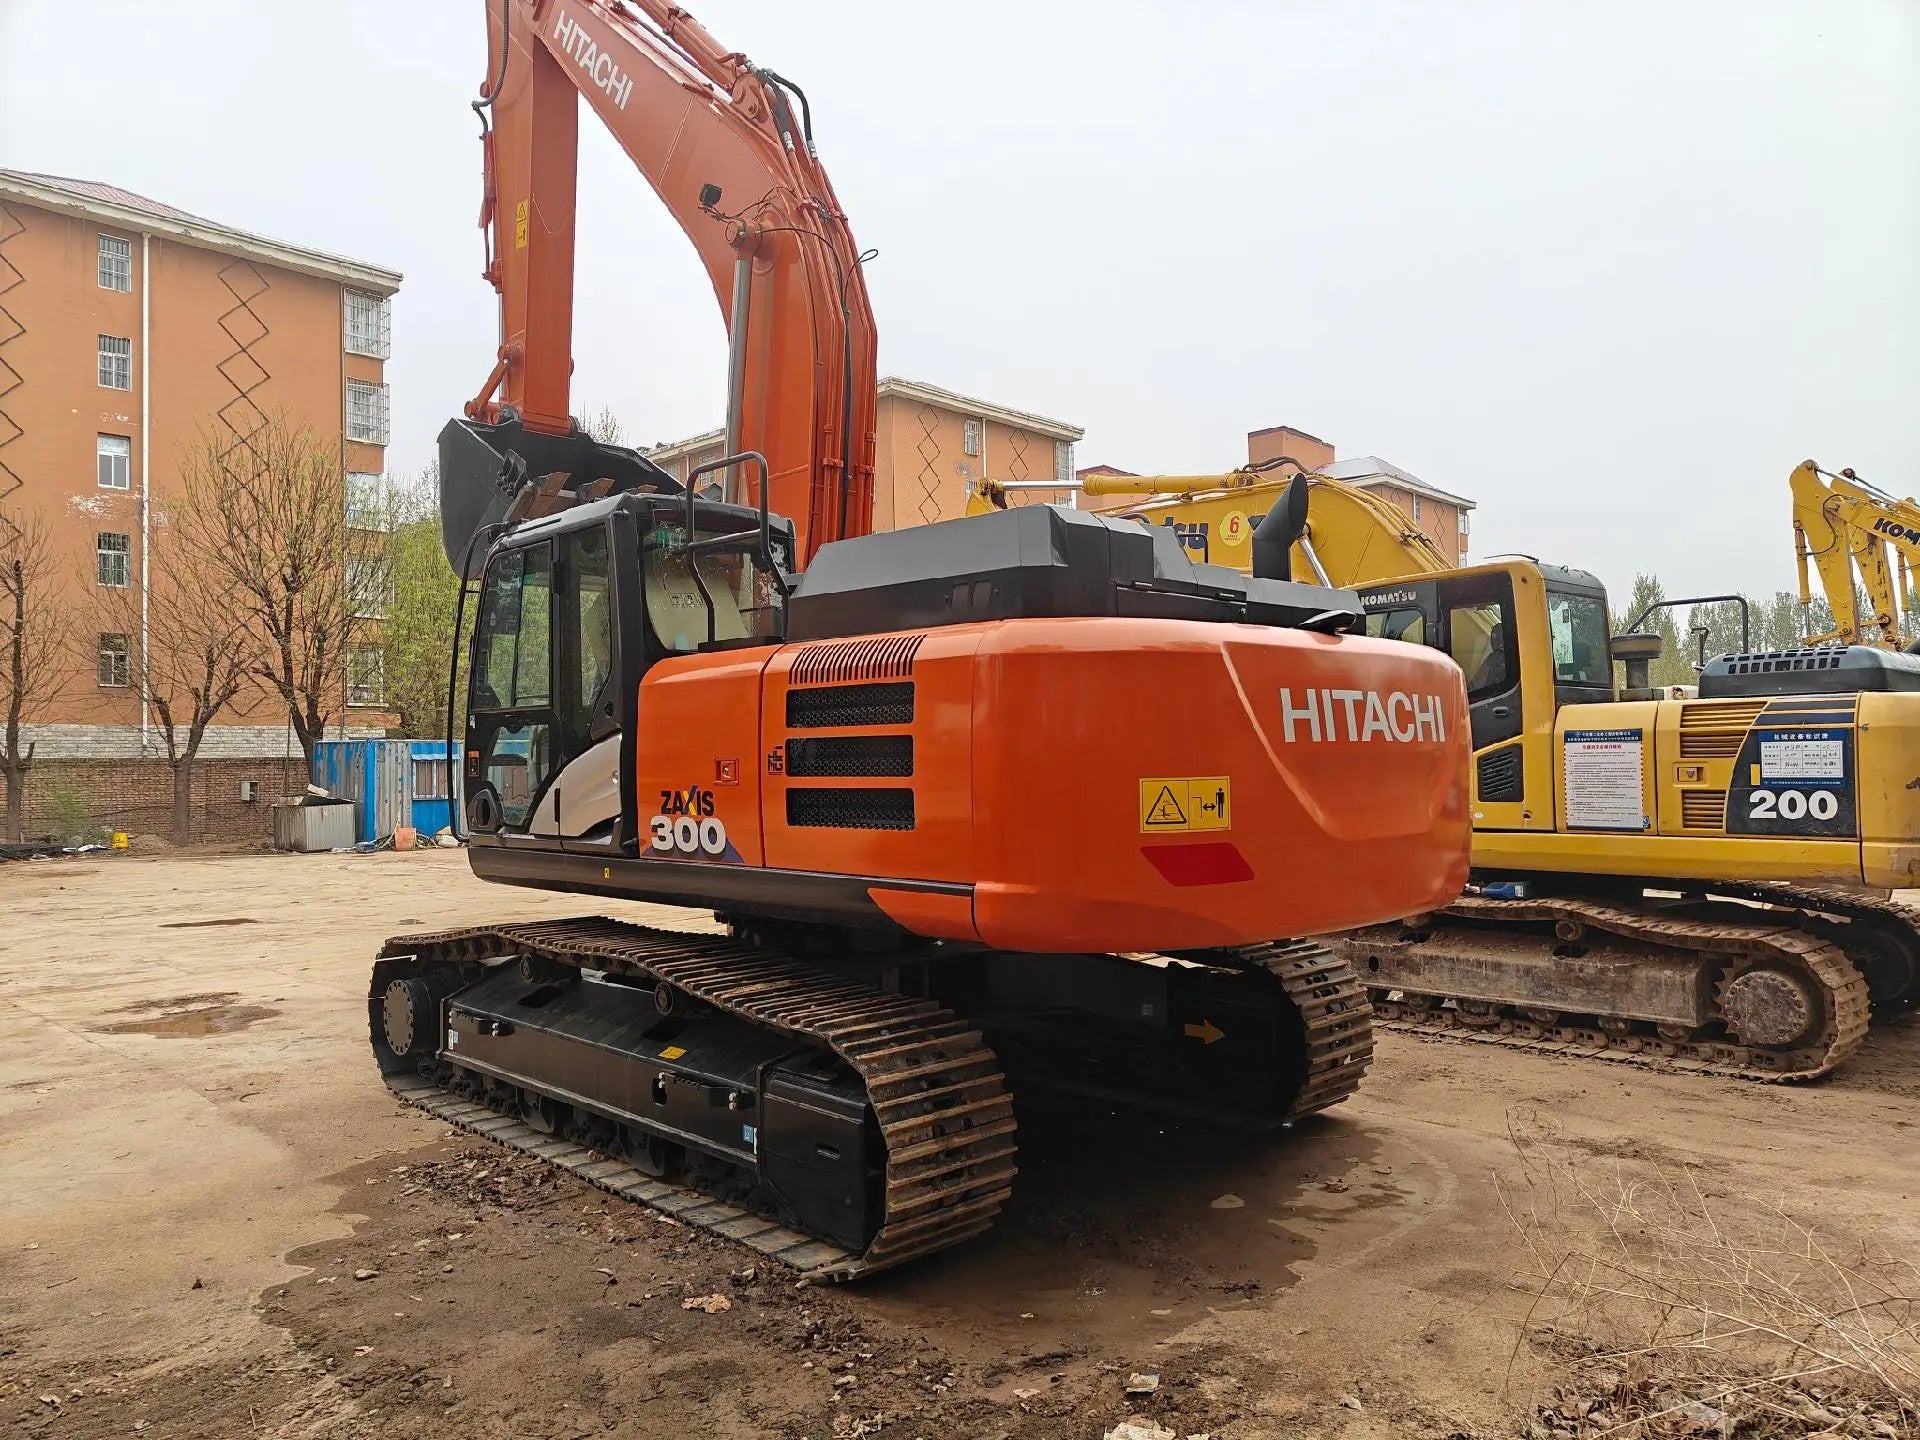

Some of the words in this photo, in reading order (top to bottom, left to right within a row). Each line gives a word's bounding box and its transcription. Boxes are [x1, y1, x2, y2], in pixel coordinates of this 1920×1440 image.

[553, 8, 634, 111] HITACHI
[1229, 515, 1240, 534] 6
[1360, 590, 1417, 606] KOMATSU
[1279, 687, 1446, 743] HITACHI
[660, 785, 715, 816] ZAXIS
[1749, 789, 1839, 820] 200
[650, 815, 727, 855] 300
